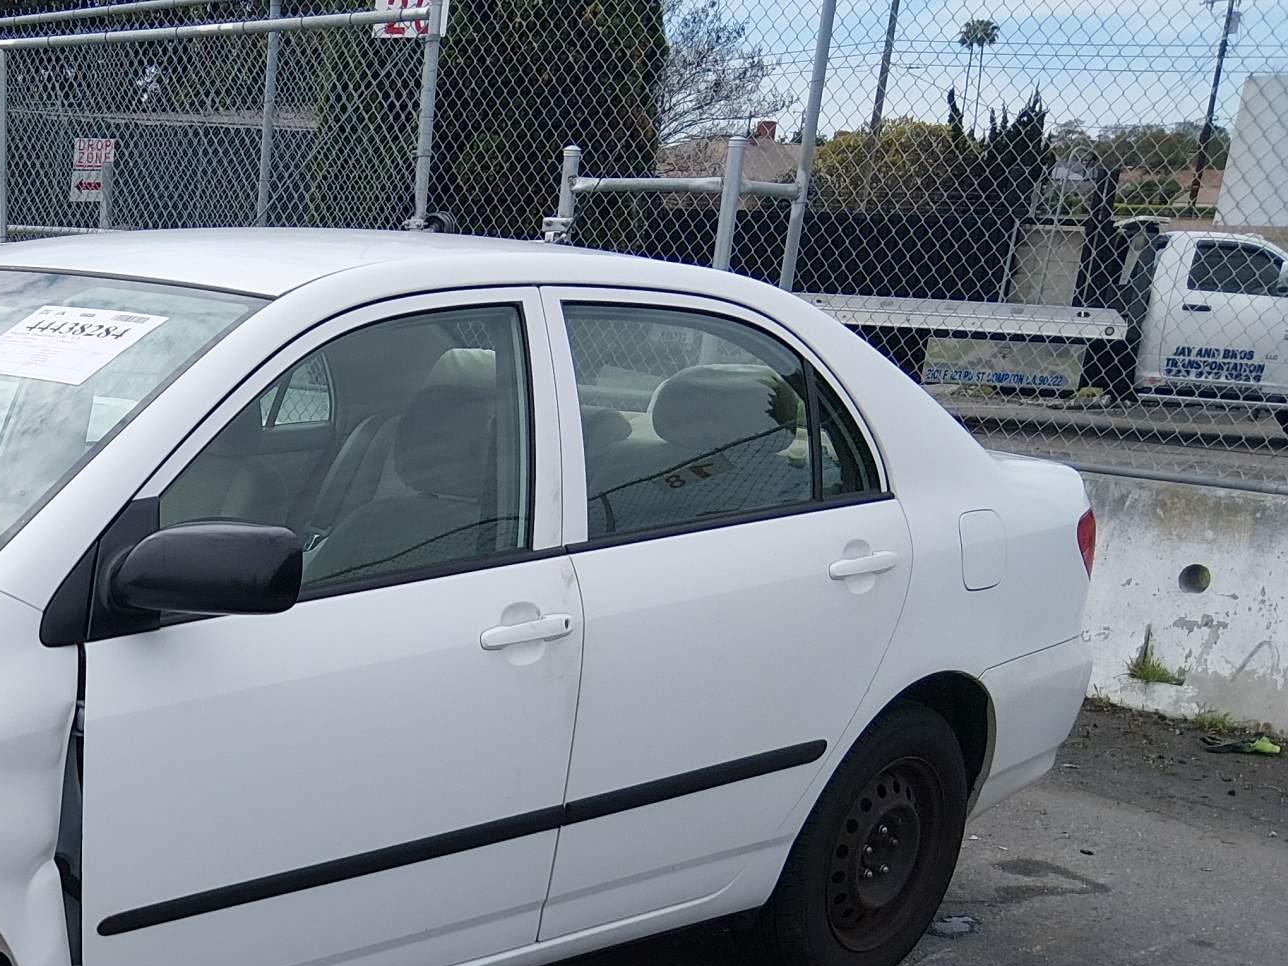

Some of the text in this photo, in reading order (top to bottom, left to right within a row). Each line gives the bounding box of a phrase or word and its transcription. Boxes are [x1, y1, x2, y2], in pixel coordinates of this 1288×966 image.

[78, 139, 112, 151] DROP
[77, 151, 111, 164] ZONE
[26, 319, 131, 340] 44438284
[1173, 345, 1255, 361] JAY AND BROS
[1165, 357, 1266, 374] TRANSPORTATION
